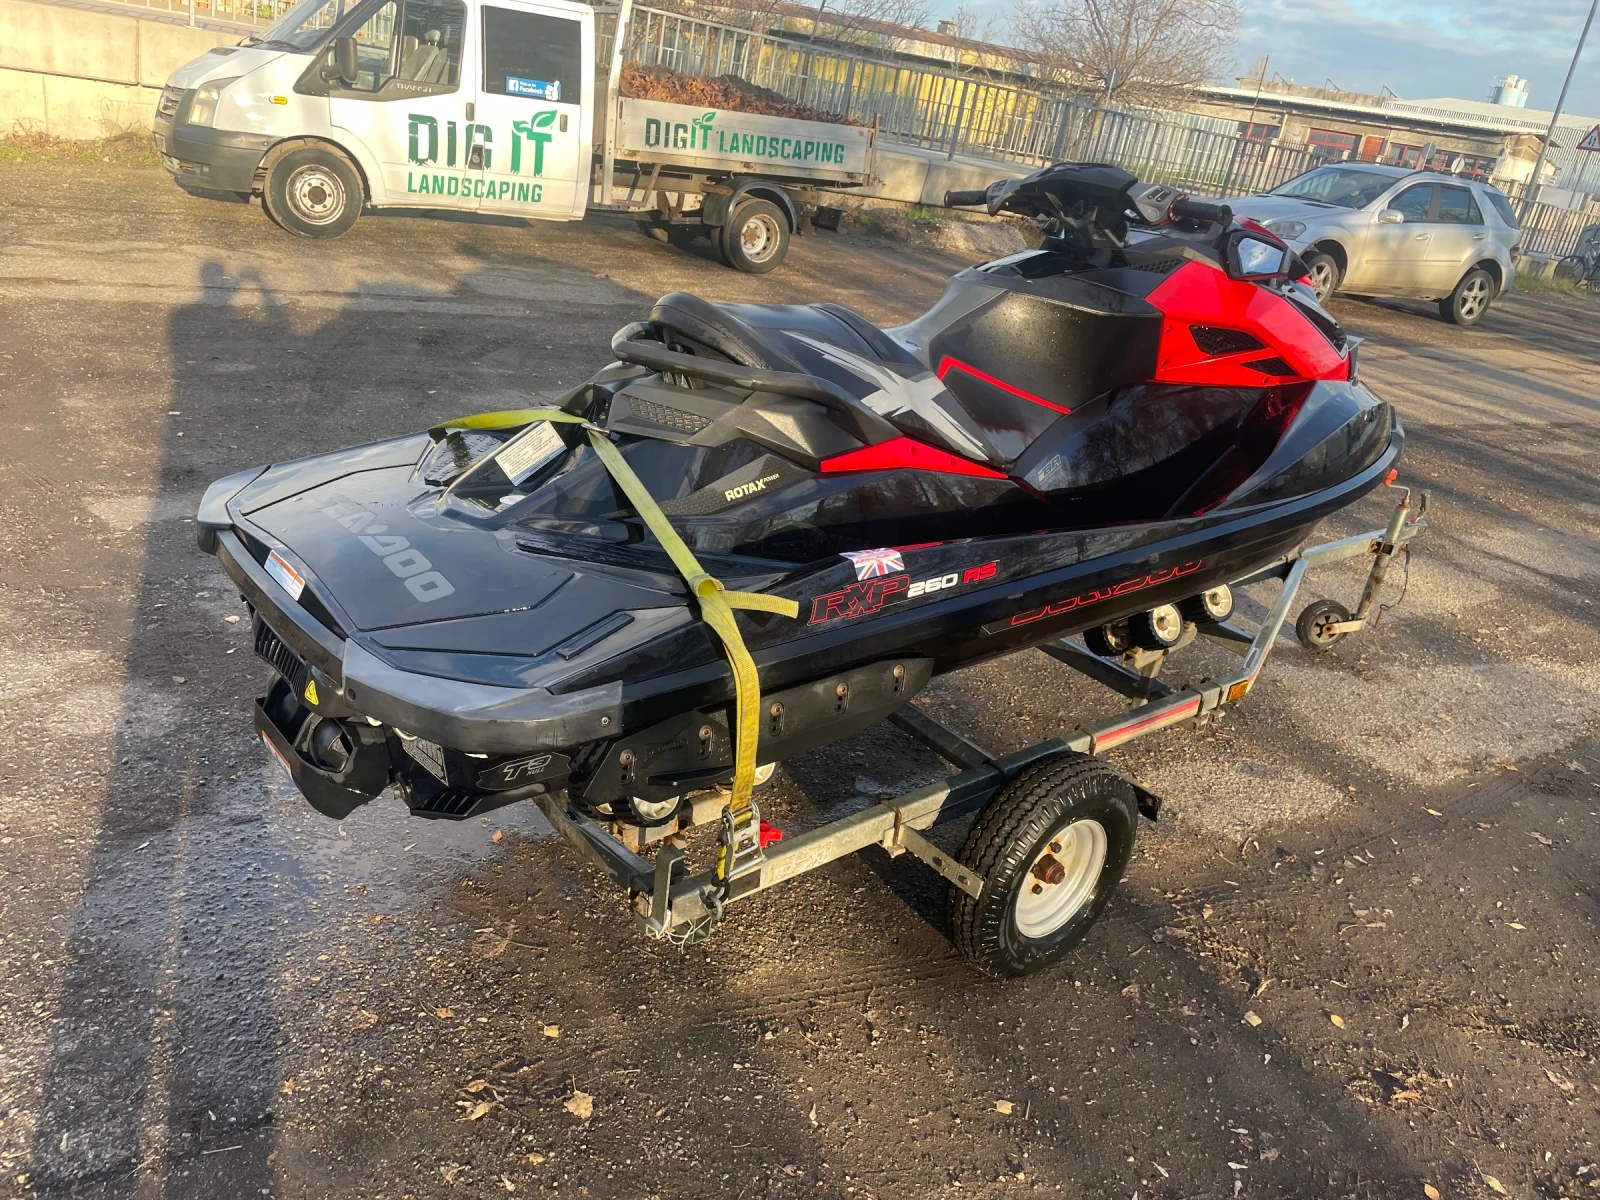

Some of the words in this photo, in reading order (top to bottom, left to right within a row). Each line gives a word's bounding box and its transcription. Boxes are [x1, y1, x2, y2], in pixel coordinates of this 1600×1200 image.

[519, 86, 544, 95] Facebook
[408, 113, 493, 171] DIG
[510, 120, 554, 178] IT
[718, 130, 845, 164] LANDSCAPING
[407, 172, 543, 203] LANDSCAPING
[724, 479, 767, 502] ROTAX
[809, 574, 912, 625] RXP
[907, 573, 959, 599] 260
